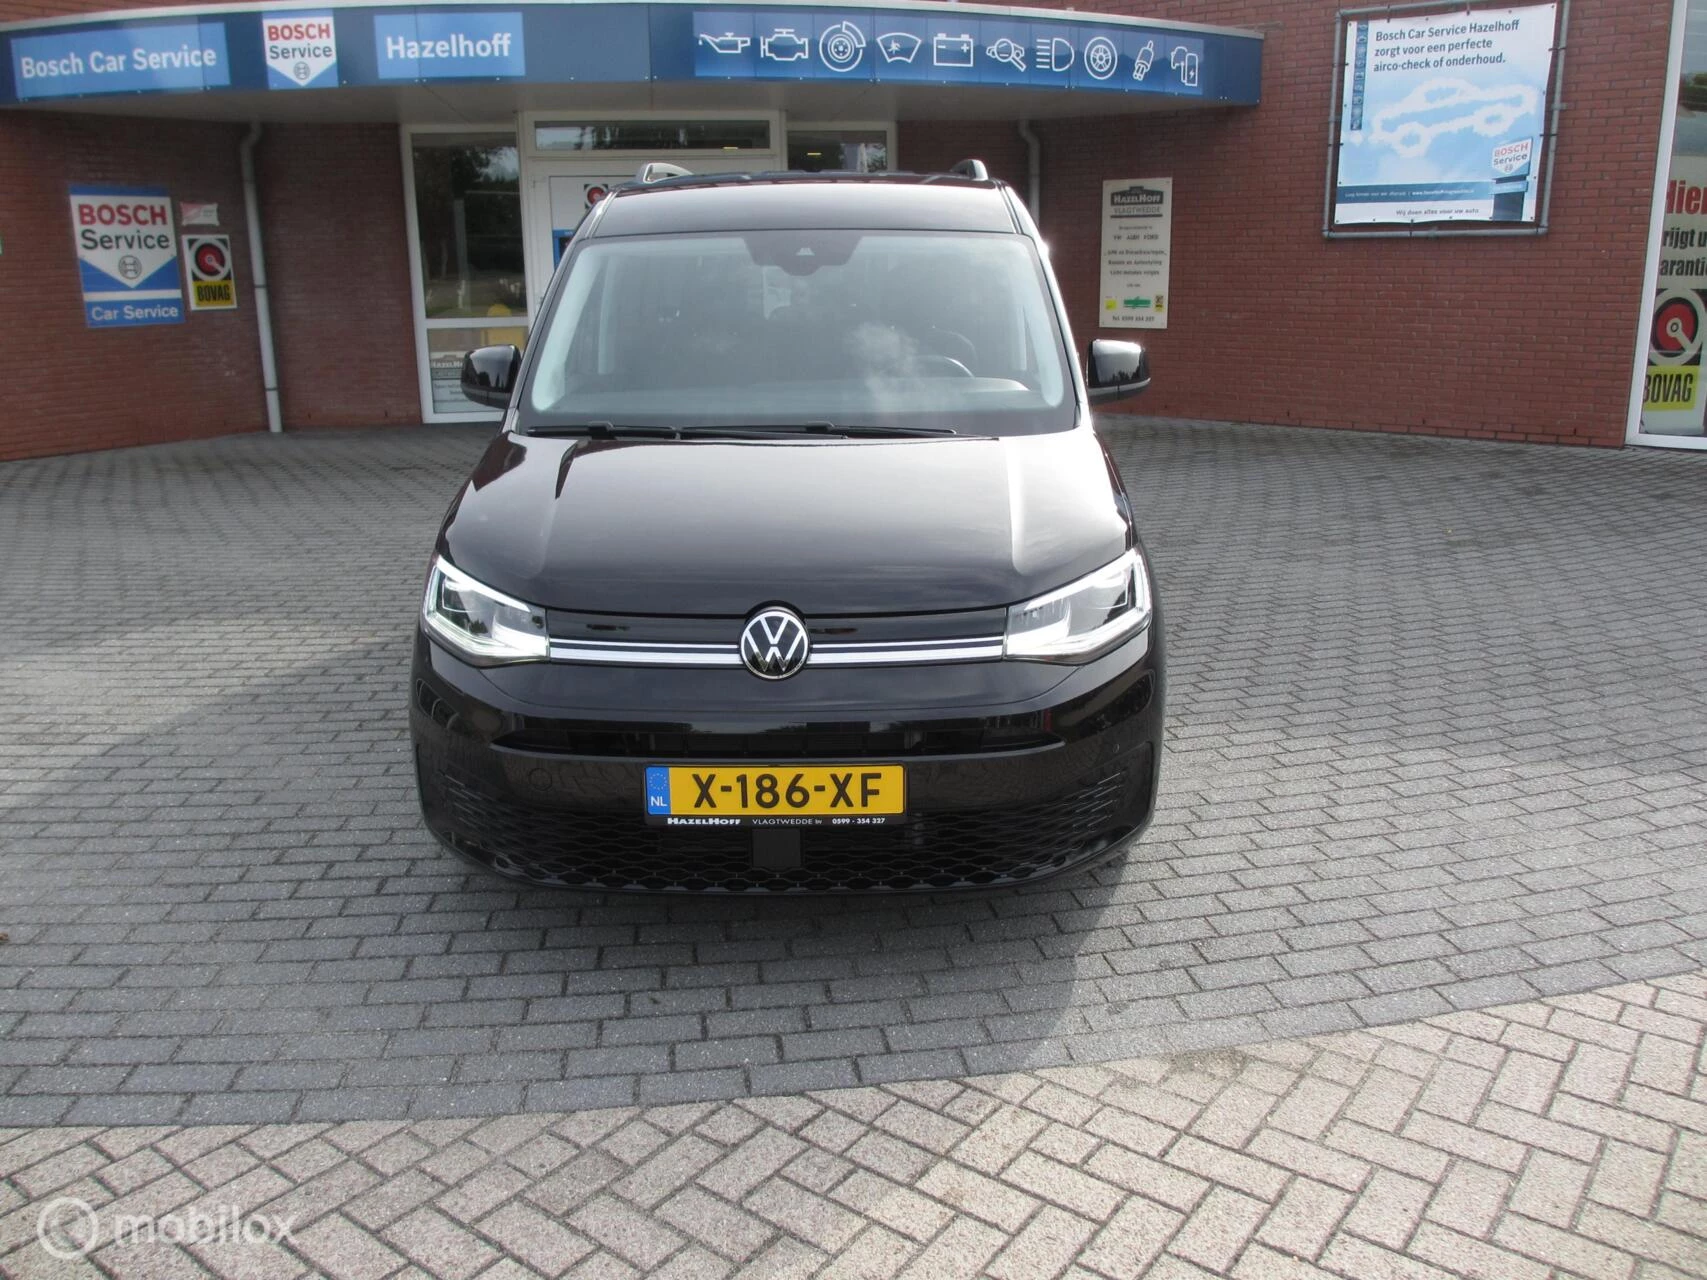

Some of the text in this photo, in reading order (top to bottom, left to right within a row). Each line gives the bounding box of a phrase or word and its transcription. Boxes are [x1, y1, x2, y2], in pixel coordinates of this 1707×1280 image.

[267, 23, 331, 41] BOSCH
[1375, 19, 1520, 42] Bosch Car Service Hazelhoff
[269, 43, 333, 60] Service
[386, 33, 511, 59] Hazelhoff
[1374, 38, 1493, 58] zorgt voor een perfecte
[21, 44, 217, 79] Bosch Car Service
[1373, 52, 1506, 72] airco-check of onderhoud.
[1493, 153, 1528, 166] Service
[1494, 142, 1529, 158] BOSCH
[78, 204, 168, 226] BOSCH
[1113, 205, 1161, 215] VLAGTWEDDE
[81, 228, 170, 250] Service
[1662, 226, 1695, 250] rijgt
[1659, 257, 1707, 276] aranti
[196, 284, 231, 302] BOVAG
[91, 304, 179, 321] Car Service
[692, 772, 882, 809] X-186-XF
[650, 795, 667, 807] NL
[832, 817, 851, 825] 0599
